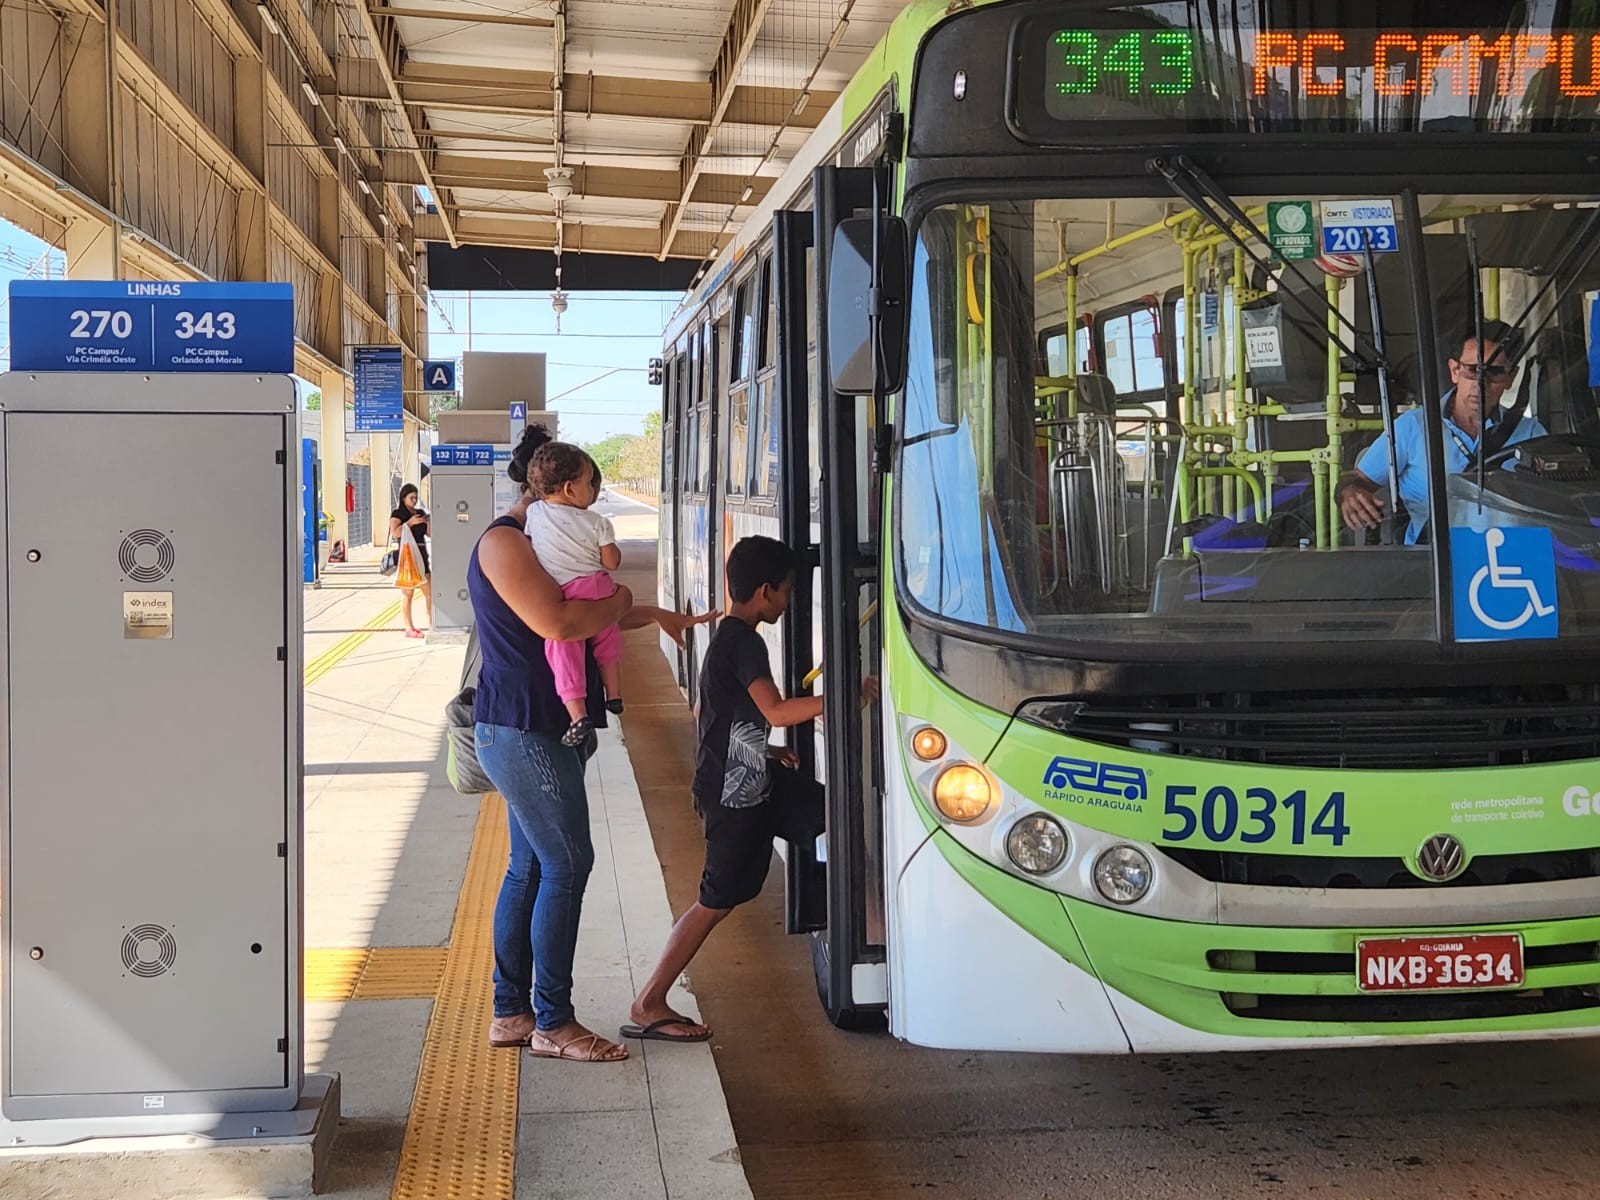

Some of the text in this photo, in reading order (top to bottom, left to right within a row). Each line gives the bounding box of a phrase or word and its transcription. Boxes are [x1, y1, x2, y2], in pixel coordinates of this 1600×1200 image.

[1055, 31, 1600, 96] 343 PC CAMPU
[1351, 206, 1392, 220] VISTORIADO
[1330, 226, 1391, 251] 2023
[127, 284, 181, 296] LINHAS
[70, 310, 133, 339] 270
[174, 311, 236, 340] 343
[75, 347, 87, 355] PC
[88, 347, 120, 356] Campus
[185, 347, 229, 357] PC Campus
[66, 355, 137, 364] Via Criméia Oeste
[171, 356, 243, 365] Orlando de Morais
[431, 367, 448, 385] A
[512, 405, 523, 418] A
[142, 599, 168, 608] index
[1044, 788, 1143, 813] RÁPIDO ARAGUAIA
[1451, 795, 1544, 810] rede metropolitana
[1161, 785, 1351, 847] 50314
[1452, 810, 1544, 824] de transporte coletivo
